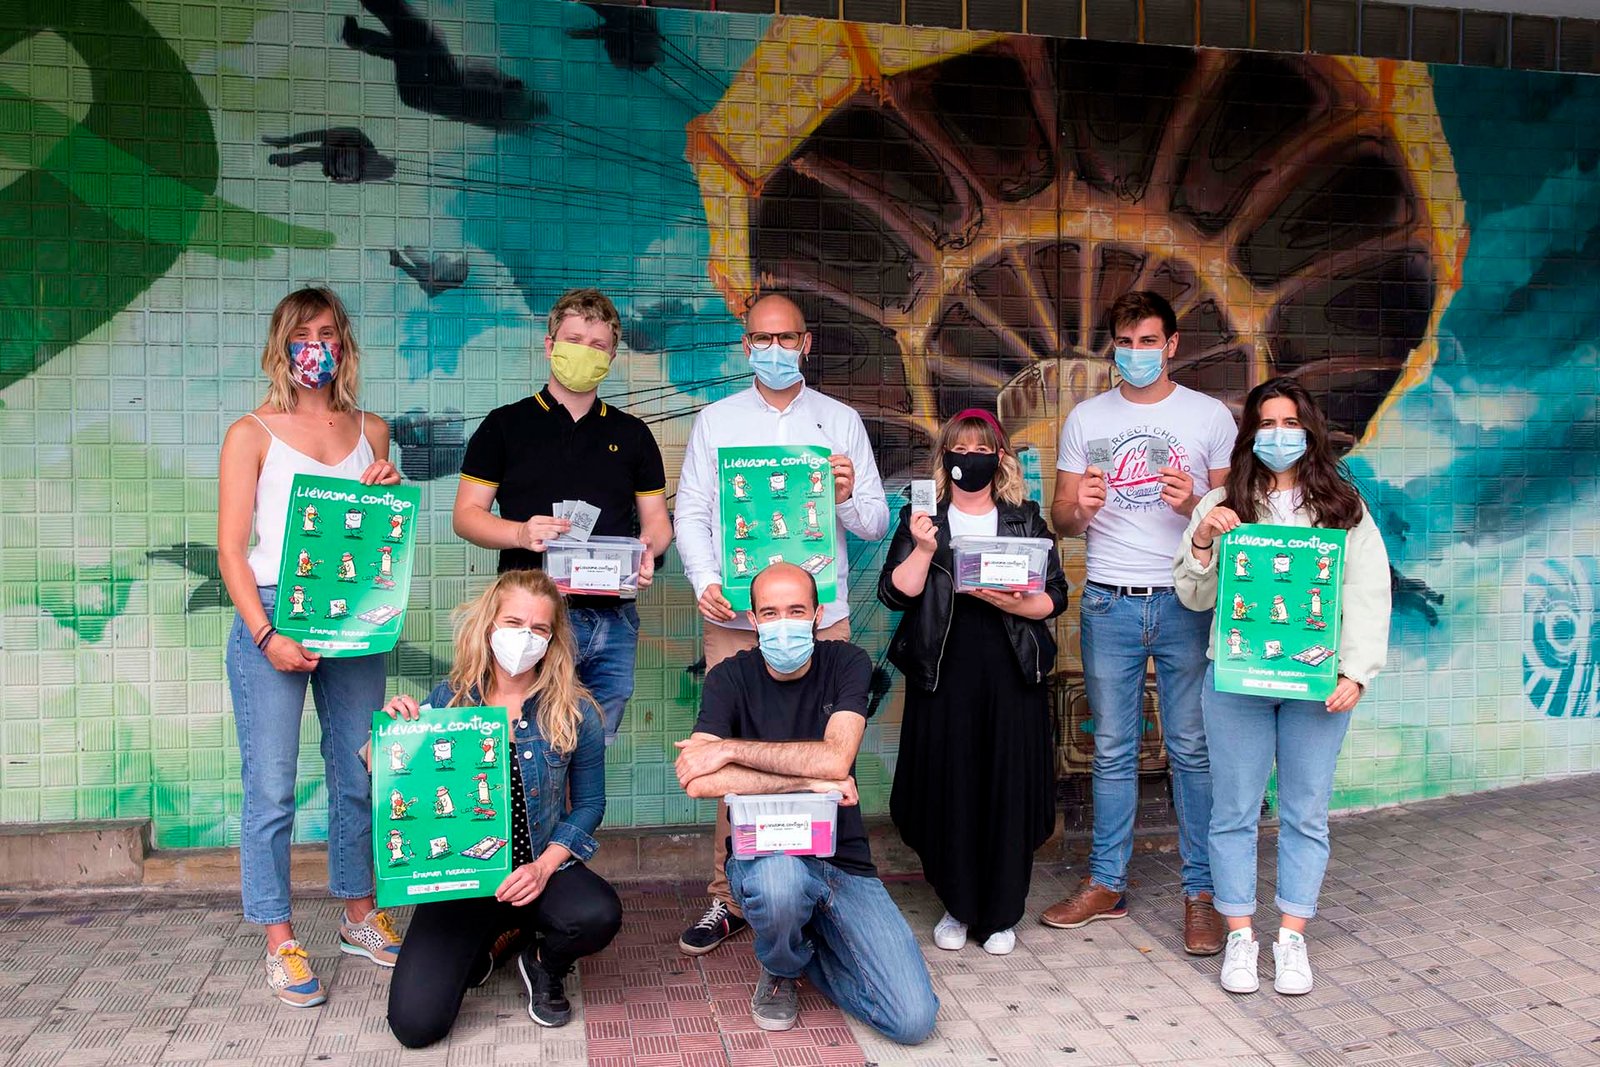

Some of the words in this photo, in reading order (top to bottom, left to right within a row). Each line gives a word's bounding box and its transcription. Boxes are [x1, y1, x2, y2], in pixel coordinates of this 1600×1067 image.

[1153, 426, 1189, 461] CHOICE
[781, 452, 828, 469] contigo
[361, 491, 412, 512] contigo
[1112, 496, 1140, 513] PLAY
[1288, 535, 1338, 555] contigo
[447, 714, 501, 735] contigo
